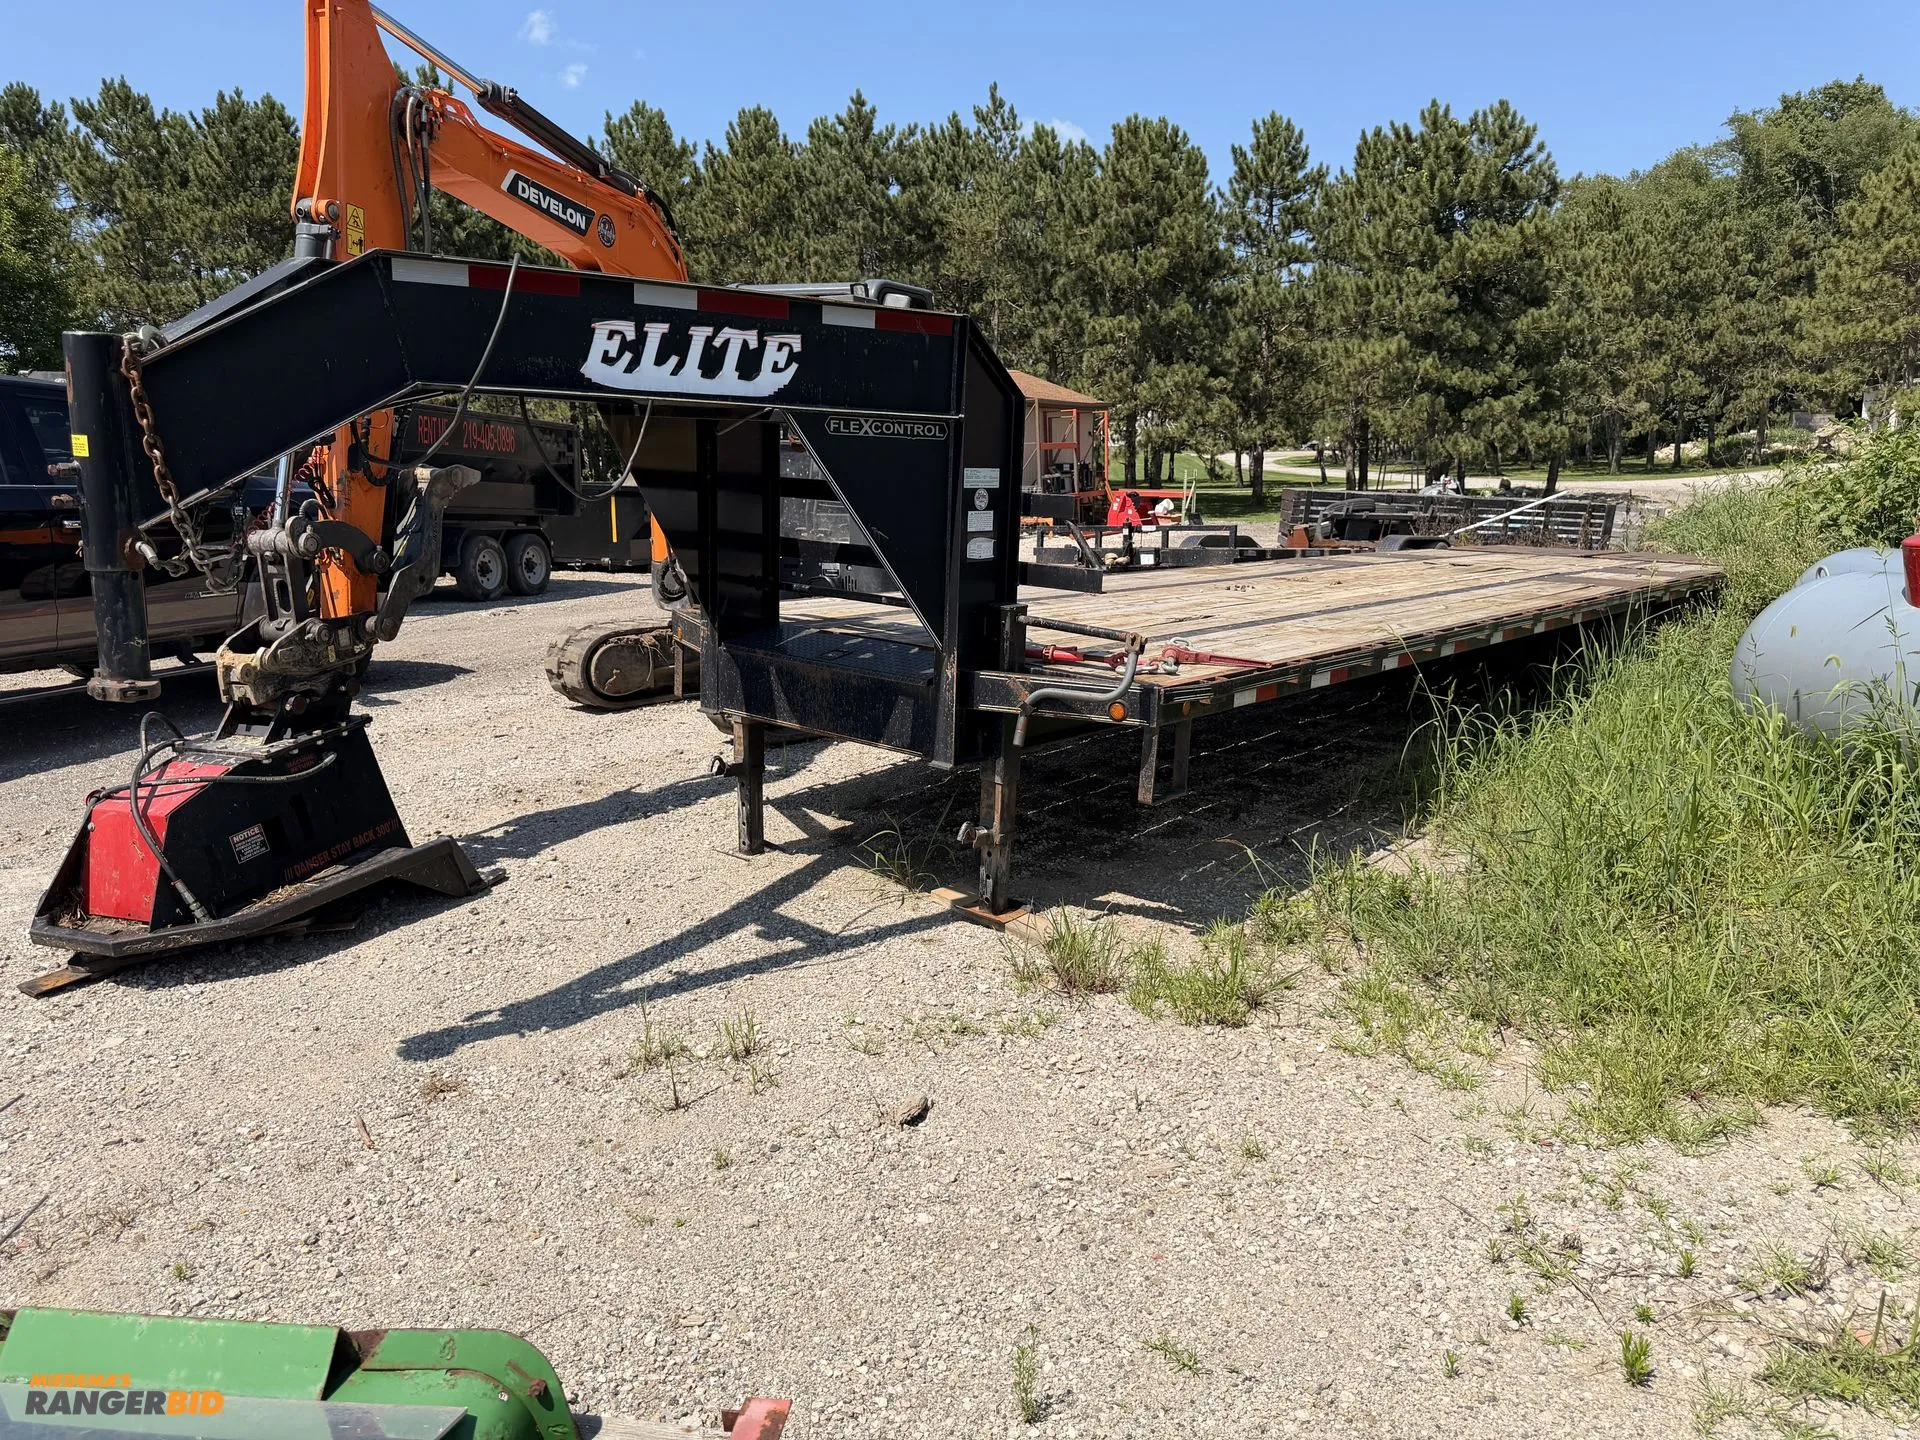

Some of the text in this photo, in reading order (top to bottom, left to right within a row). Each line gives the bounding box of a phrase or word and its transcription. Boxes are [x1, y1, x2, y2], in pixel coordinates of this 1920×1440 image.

[518, 180, 586, 230] DEVELON
[580, 319, 802, 397] ELITE
[418, 415, 437, 445] RENT
[463, 420, 516, 453] 219-405-0896
[829, 418, 944, 437] FLEXCONTROL
[233, 827, 260, 843] NOTICE
[293, 850, 331, 876] DANGER
[330, 840, 352, 859] STAY
[352, 829, 376, 848] BACK
